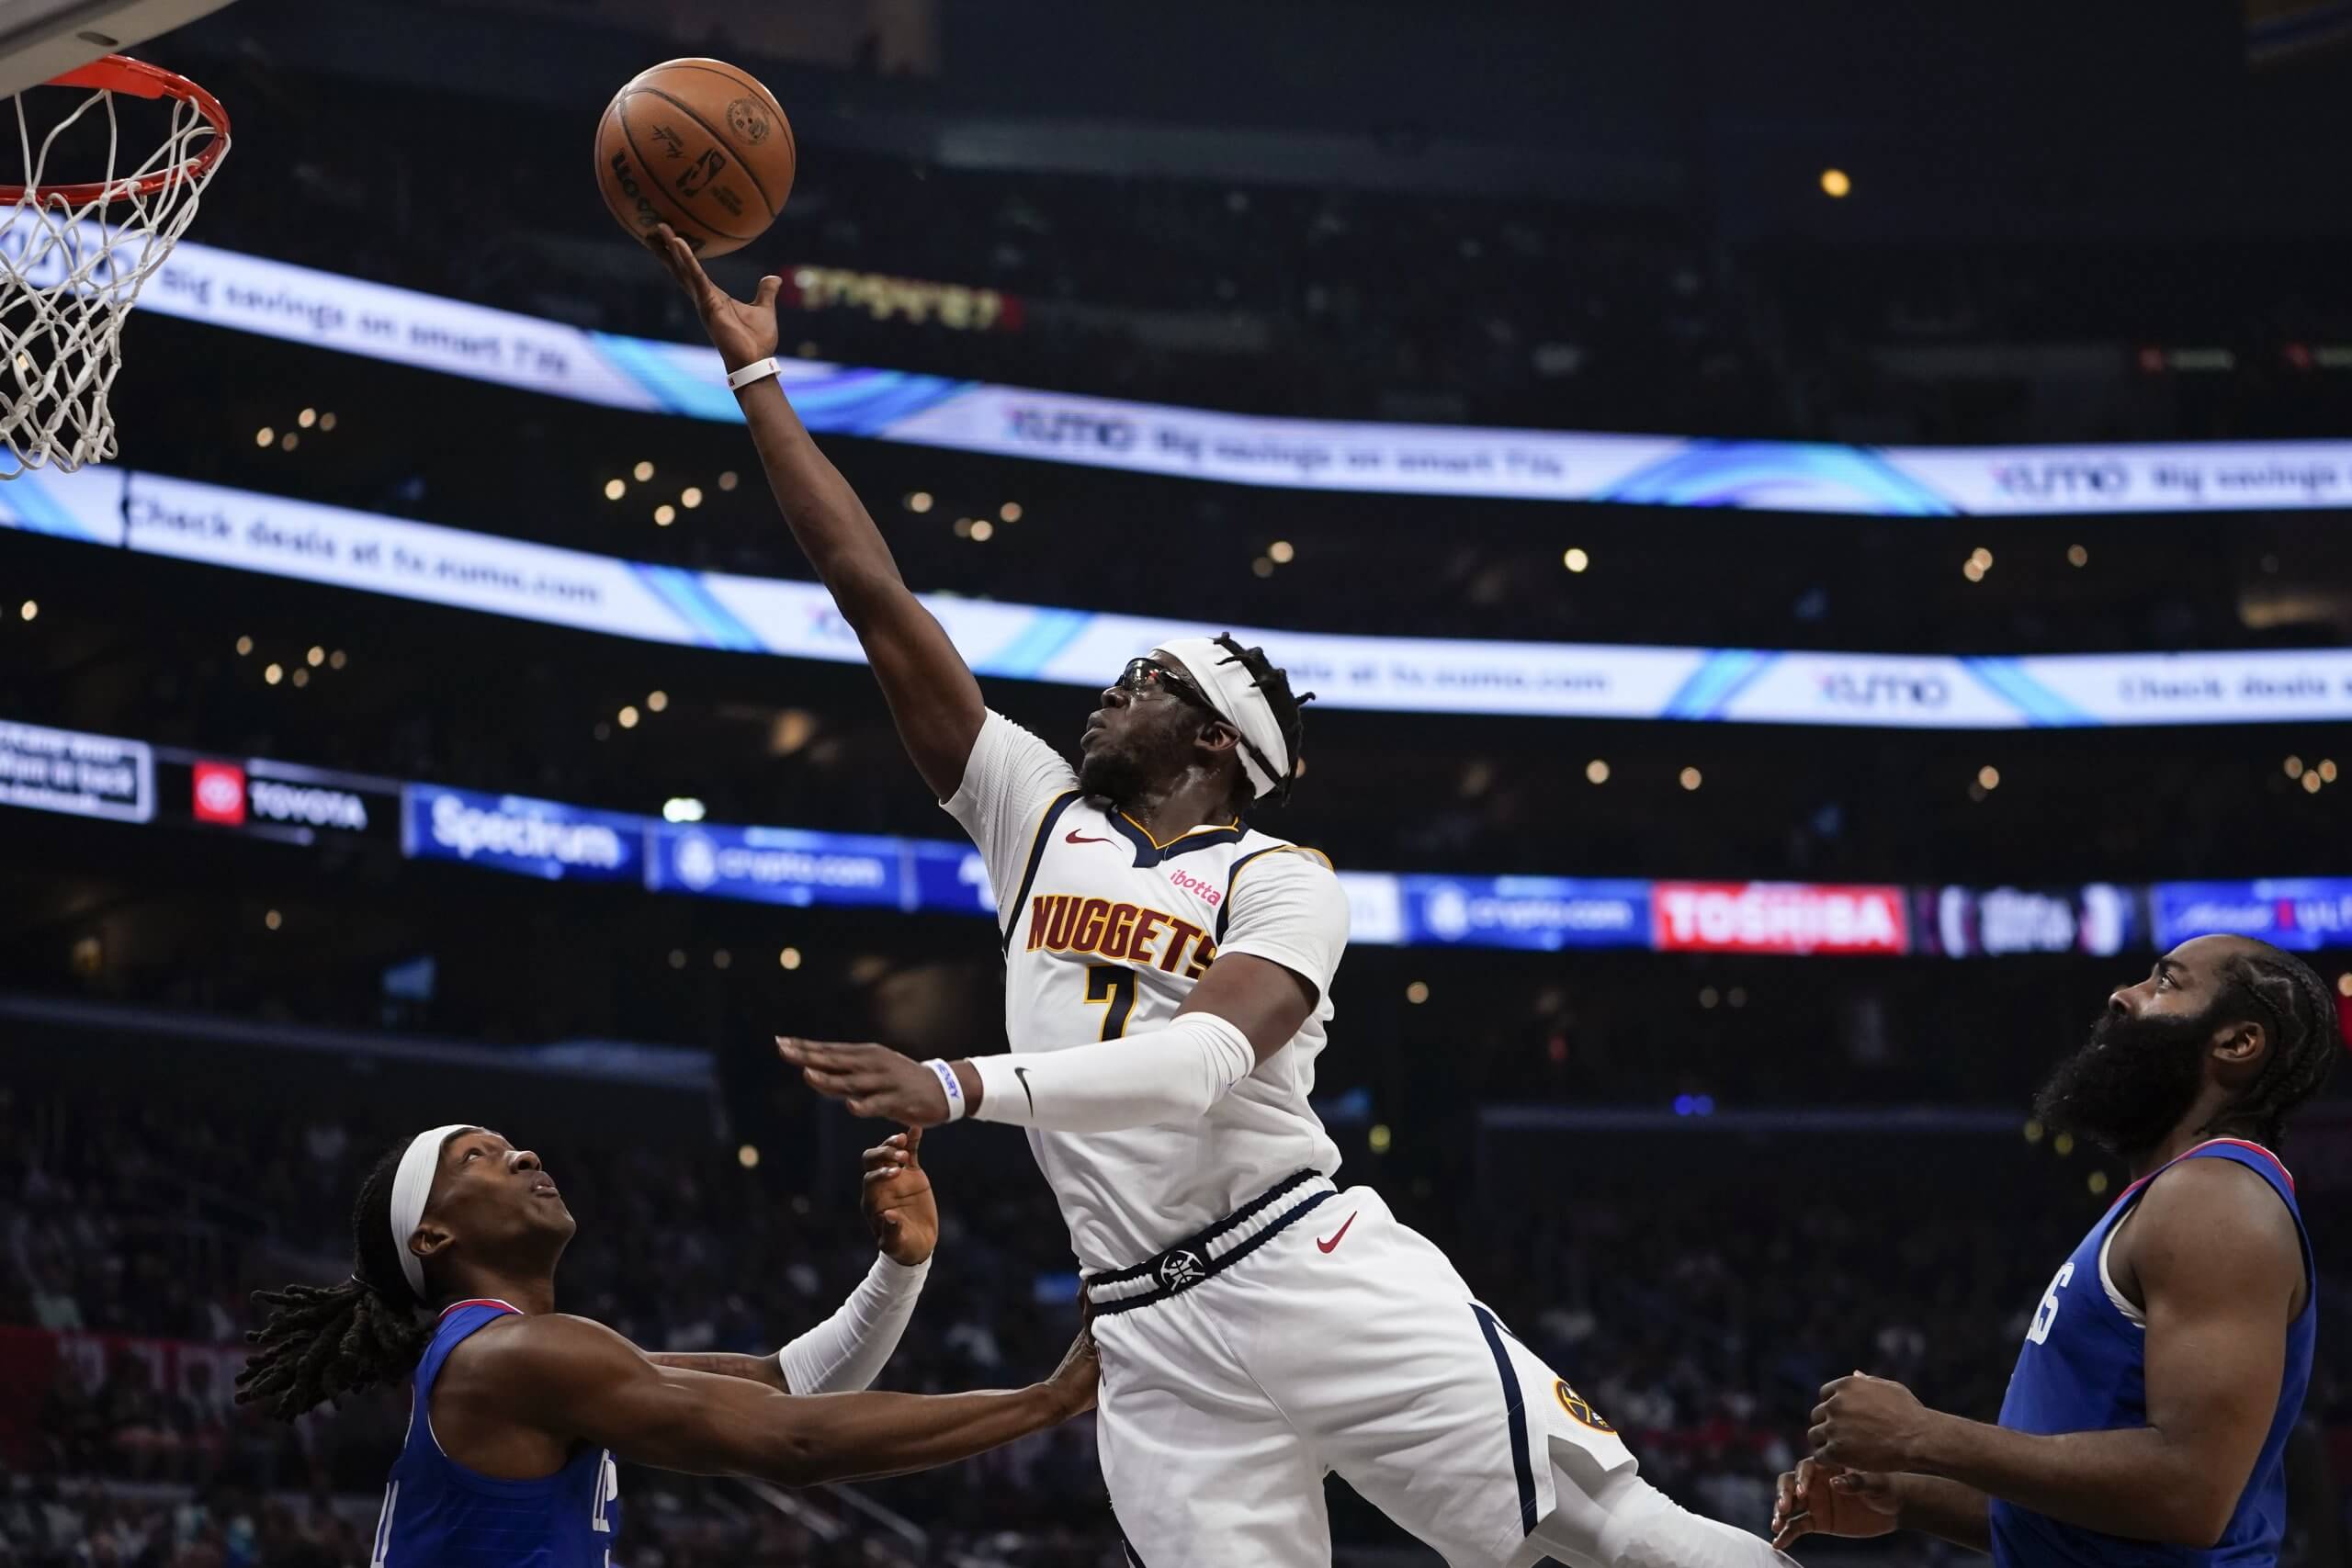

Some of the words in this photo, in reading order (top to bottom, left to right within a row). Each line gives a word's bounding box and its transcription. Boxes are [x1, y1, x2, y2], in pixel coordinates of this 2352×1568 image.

[225, 284, 345, 331] savings
[358, 315, 395, 336] on
[1214, 439, 1329, 478] savings
[2217, 461, 2338, 500] savings
[130, 496, 232, 537] Check
[246, 518, 336, 558] deals
[2119, 675, 2223, 701] Check
[2237, 674, 2329, 699] deals
[248, 781, 368, 830] TOYOTA
[432, 795, 620, 868] Spectrum
[718, 848, 885, 888] crypto.com
[1170, 869, 1221, 907] ibotta
[1025, 893, 1218, 981] NUGGETS
[1470, 897, 1634, 931] crypto.com
[1665, 890, 1896, 944] TOSHIBA
[1083, 964, 1139, 1043] 7
